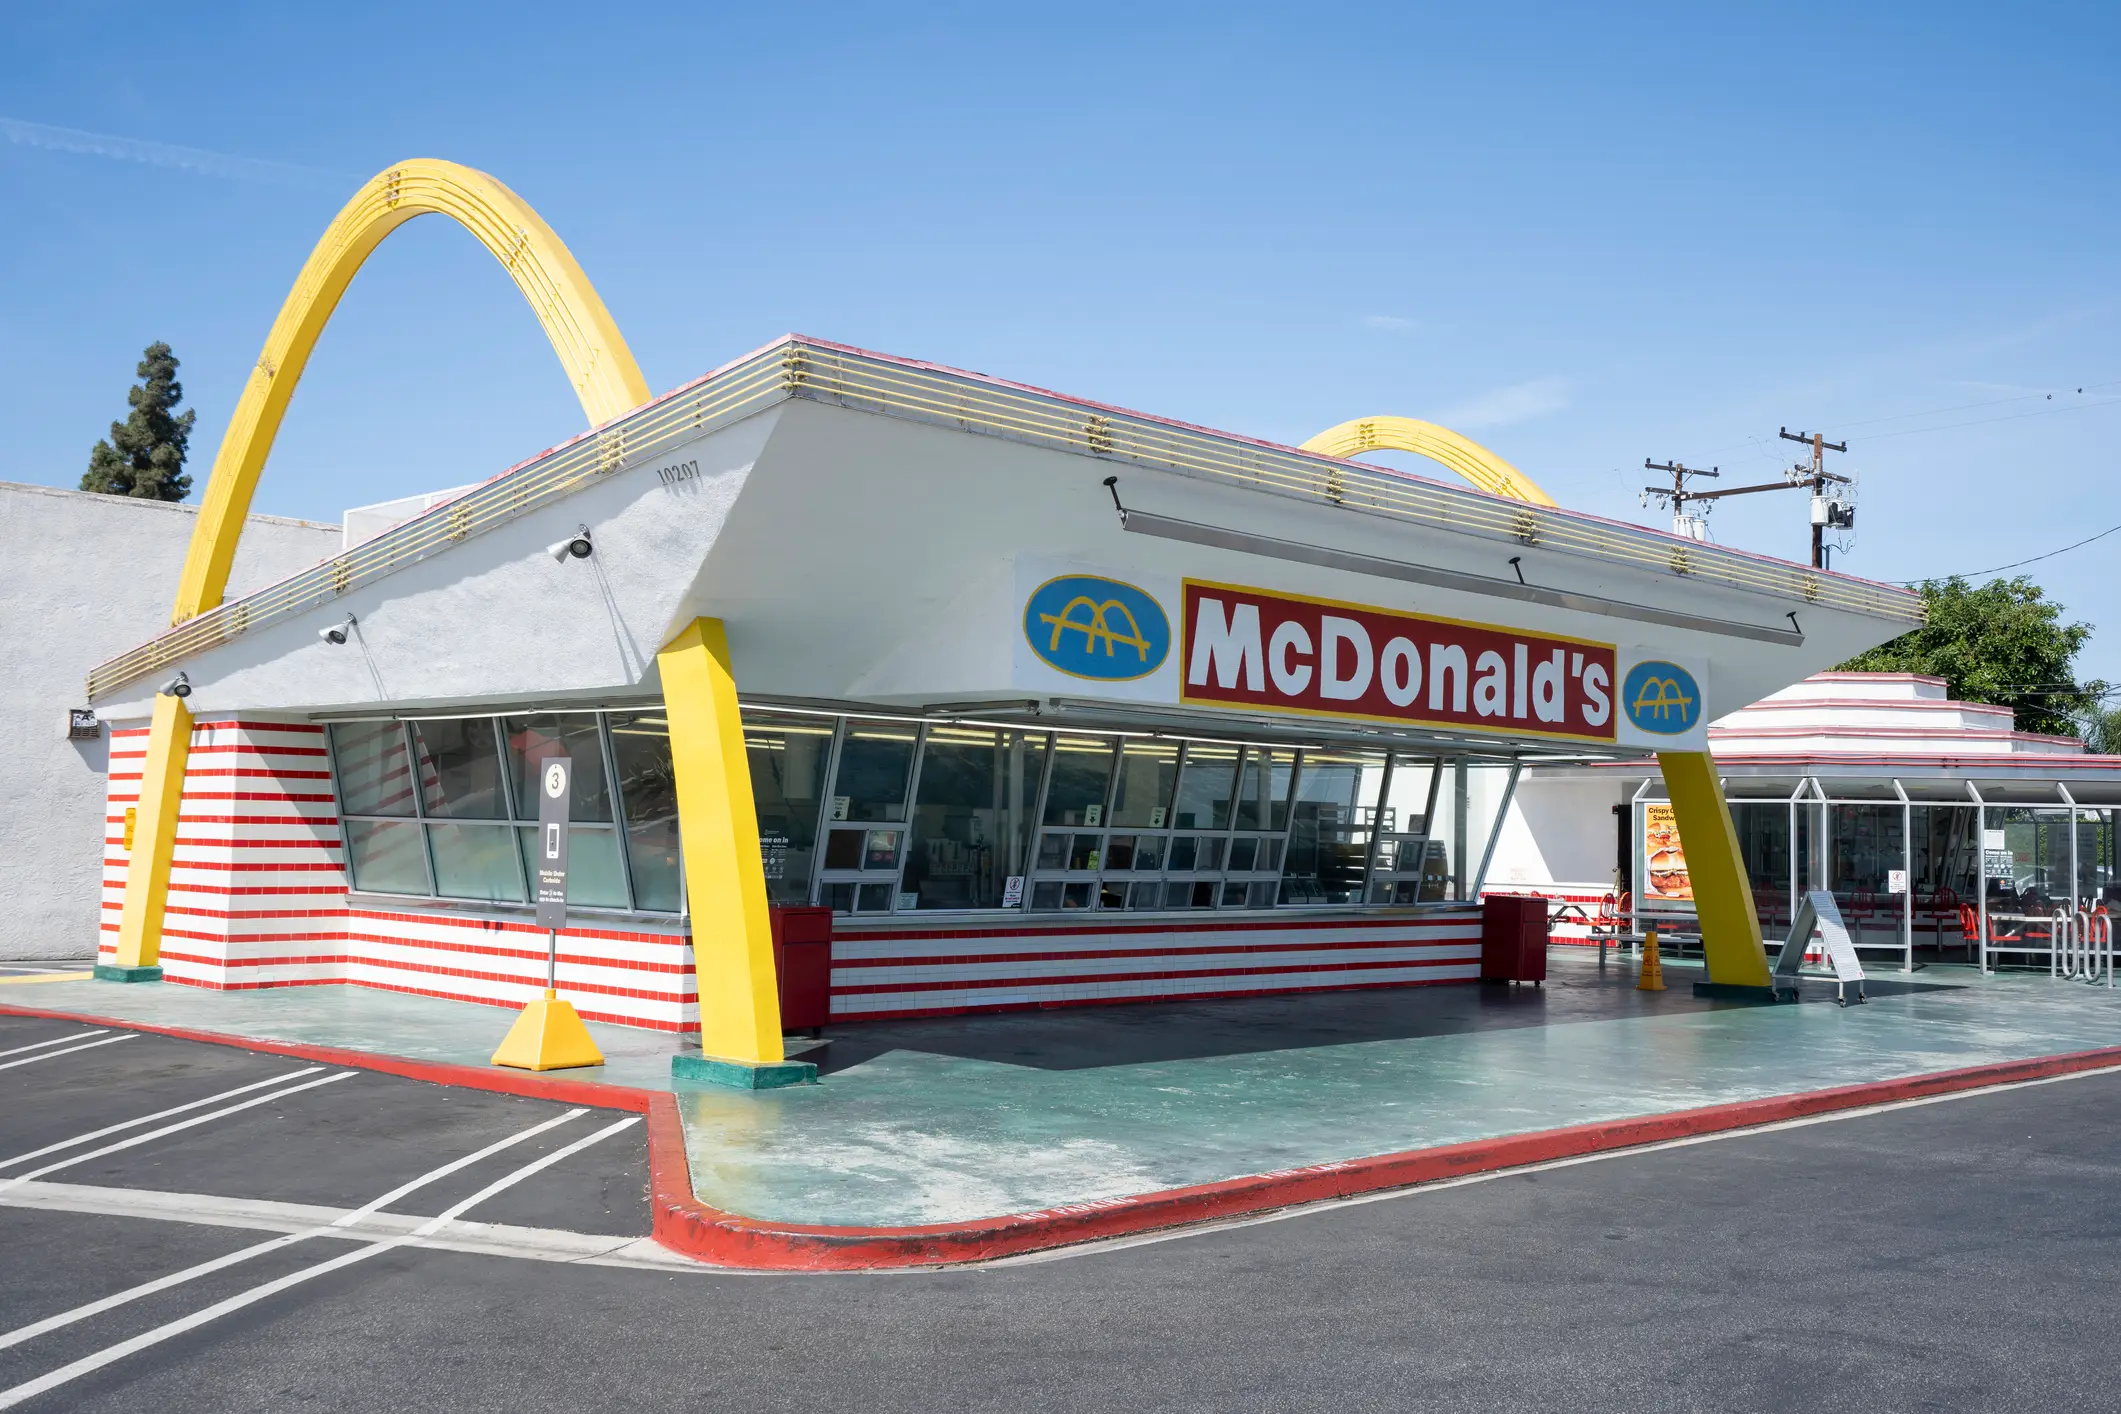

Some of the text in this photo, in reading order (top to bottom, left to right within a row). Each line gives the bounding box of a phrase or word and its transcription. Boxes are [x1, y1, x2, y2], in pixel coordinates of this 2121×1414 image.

[657, 460, 700, 485] 10207
[1188, 597, 1610, 727] McDonald's
[552, 772, 559, 789] 3
